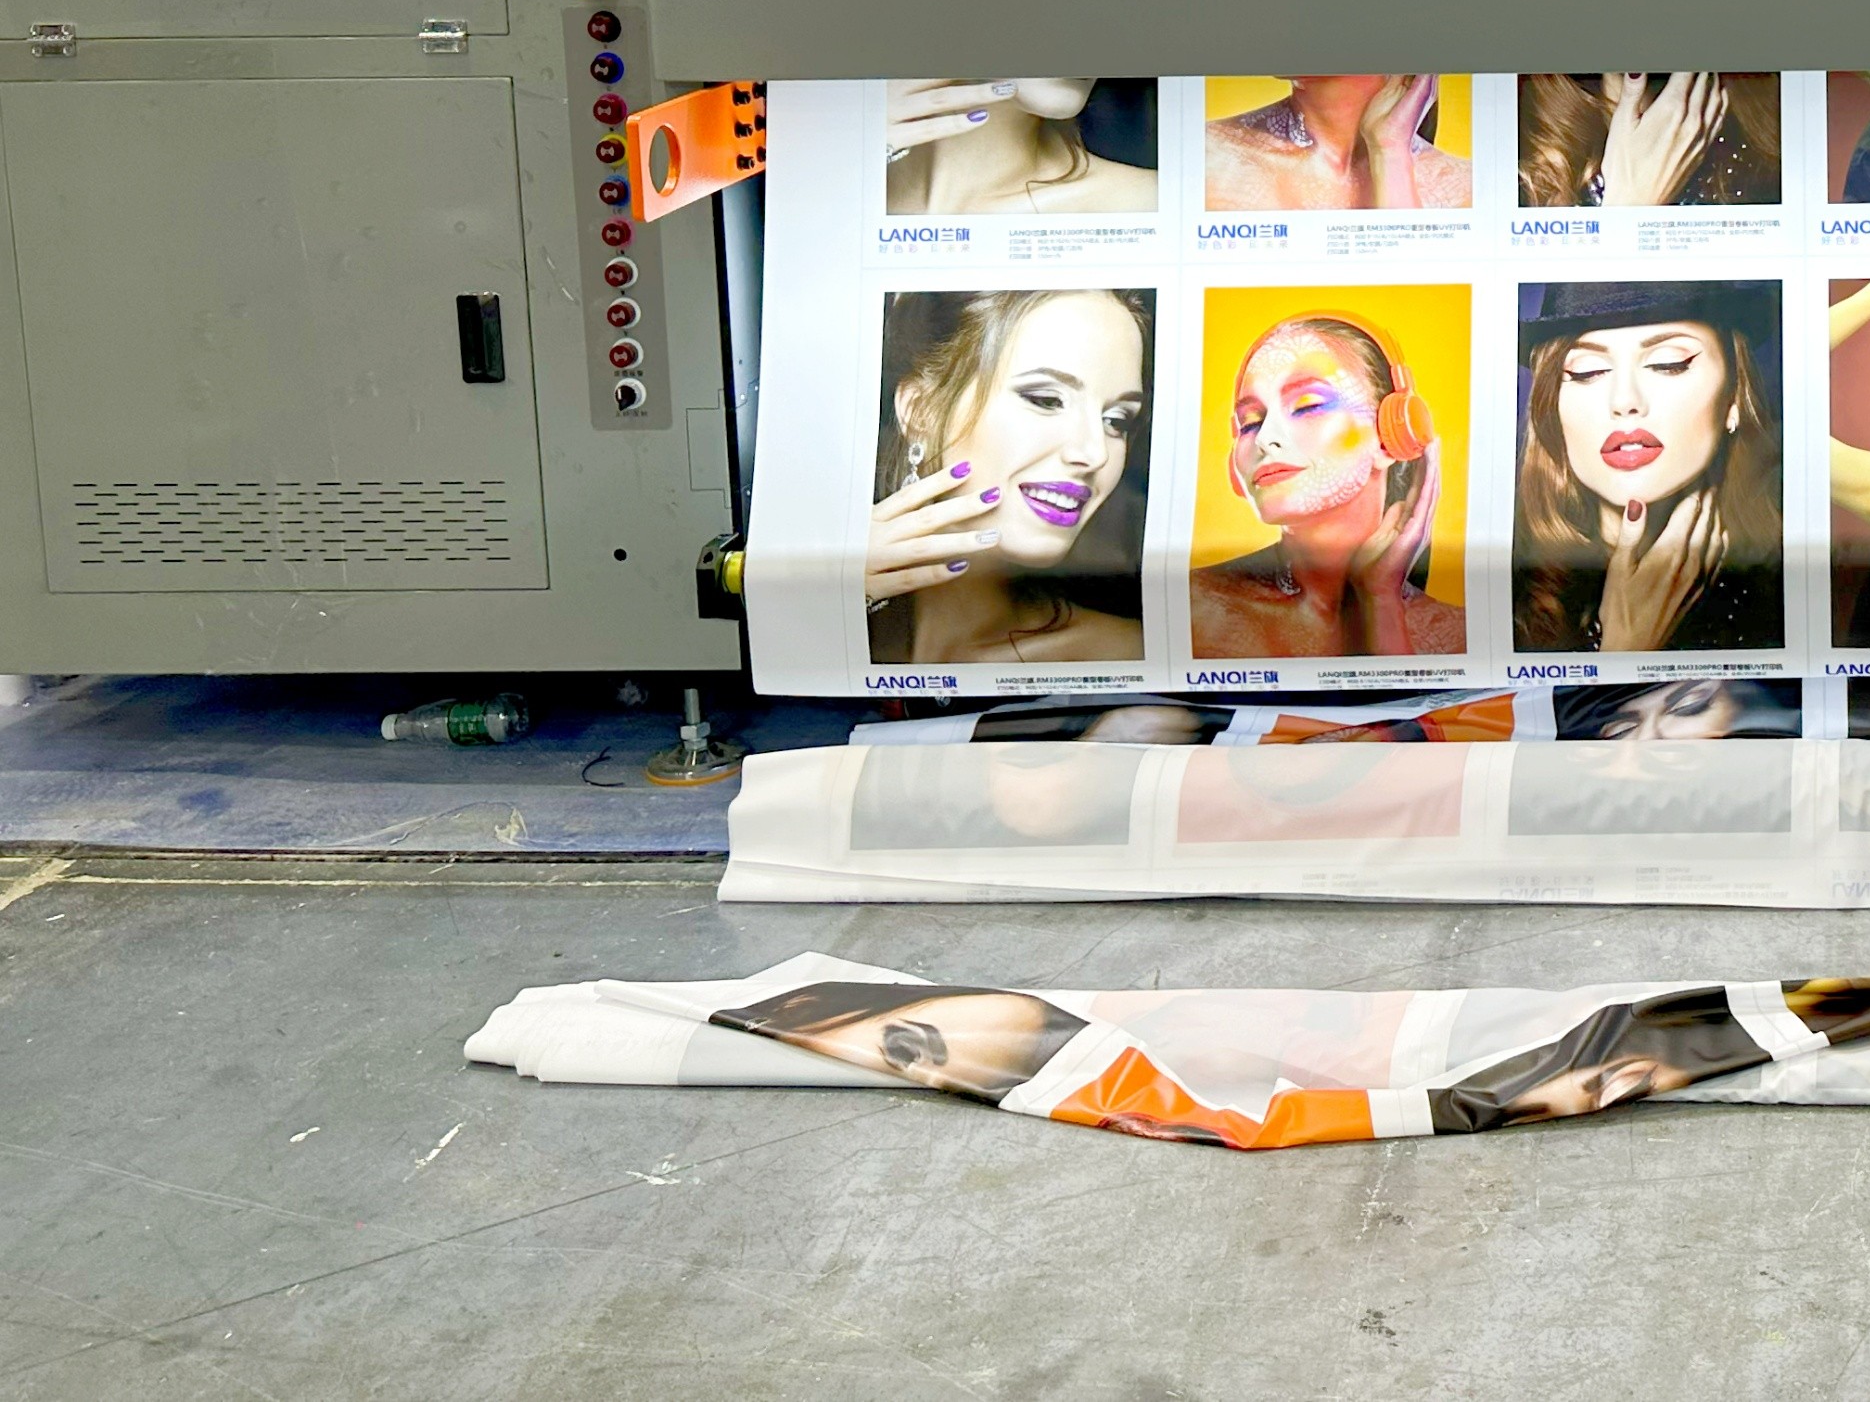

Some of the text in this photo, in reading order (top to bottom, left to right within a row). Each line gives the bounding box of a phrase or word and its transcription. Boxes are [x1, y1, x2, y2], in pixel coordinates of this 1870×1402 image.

[1198, 225, 1288, 238] LANQI兰旗
[1511, 221, 1600, 234] LANQI兰旗
[879, 228, 970, 242] LANQI兰旗
[1186, 671, 1279, 684] LANQI兰旗
[1507, 665, 1598, 678] LANQI兰旗
[865, 676, 957, 688] LANQI兰旗
